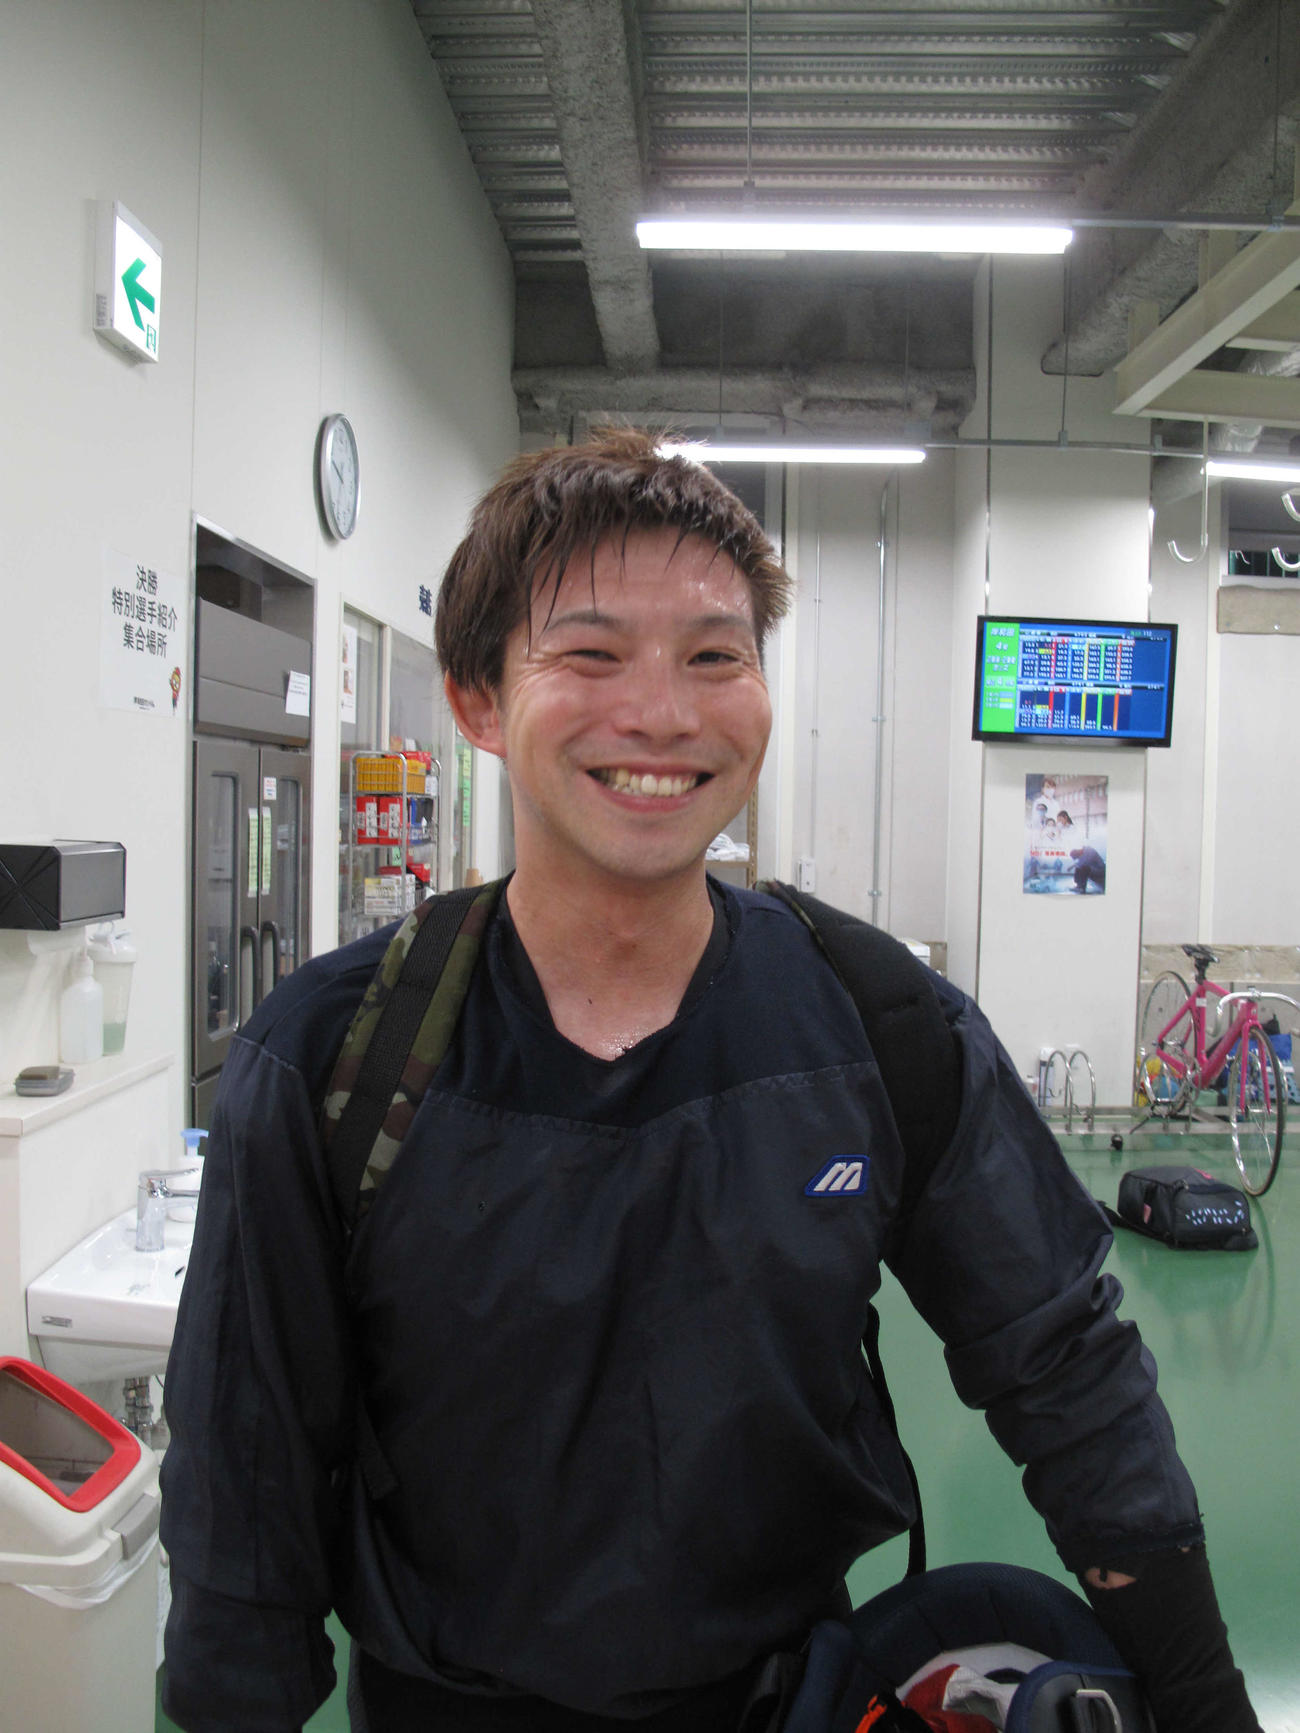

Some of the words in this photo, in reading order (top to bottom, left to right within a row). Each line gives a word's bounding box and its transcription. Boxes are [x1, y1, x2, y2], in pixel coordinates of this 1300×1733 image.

[112, 586, 178, 633] 特別選手紹介
[123, 621, 168, 658] 集合場所
